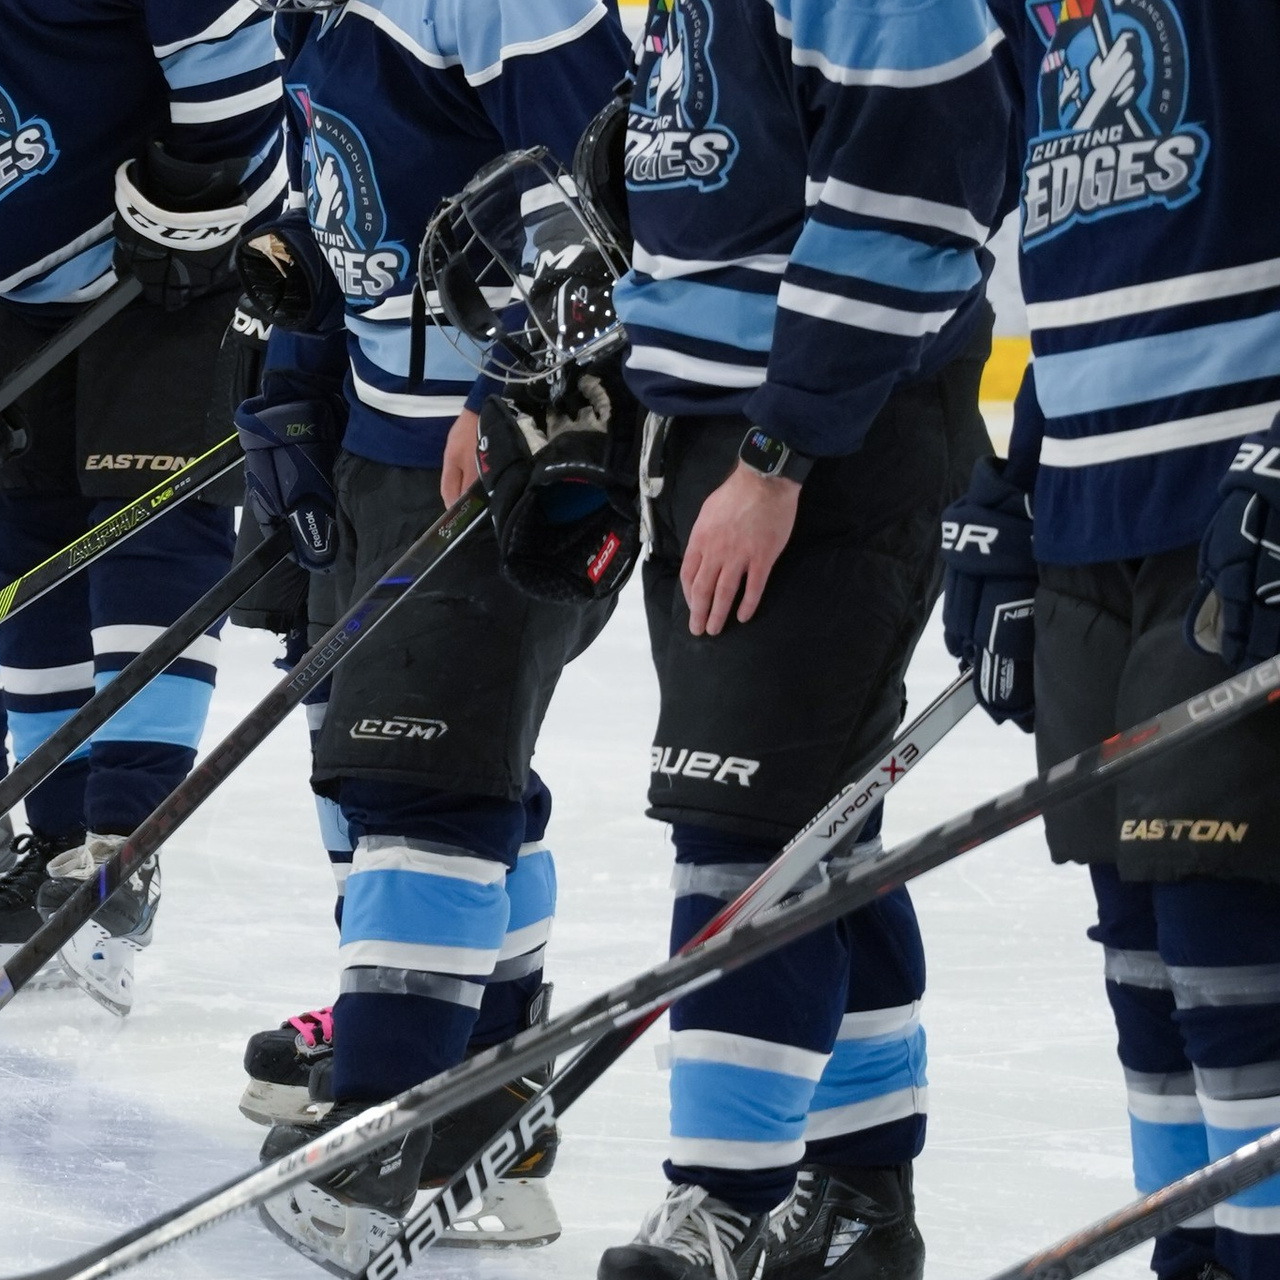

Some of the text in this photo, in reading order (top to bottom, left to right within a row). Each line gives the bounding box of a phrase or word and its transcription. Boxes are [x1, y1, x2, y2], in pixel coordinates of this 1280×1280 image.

[683, 0, 705, 83] VANCOUVER
[1159, 89, 1172, 114] BC
[1031, 124, 1124, 164] CUTTING
[325, 122, 373, 232] VANCOUVER BC
[1023, 134, 1196, 238] EDGES
[127, 206, 240, 241] CCM
[320, 247, 399, 296] GES
[285, 423, 315, 437] 10K
[85, 453, 195, 472] EASTON
[68, 502, 151, 570] ALPHA
[306, 511, 324, 549] Reebok
[592, 539, 617, 578] CCM
[287, 631, 351, 693] TRIGGER
[345, 617, 361, 635] 9
[1186, 663, 1280, 722] COVE
[359, 718, 436, 741] CCM
[650, 745, 761, 788] AUER
[814, 780, 887, 839] VAPOR
[1120, 818, 1250, 843] EASTON
